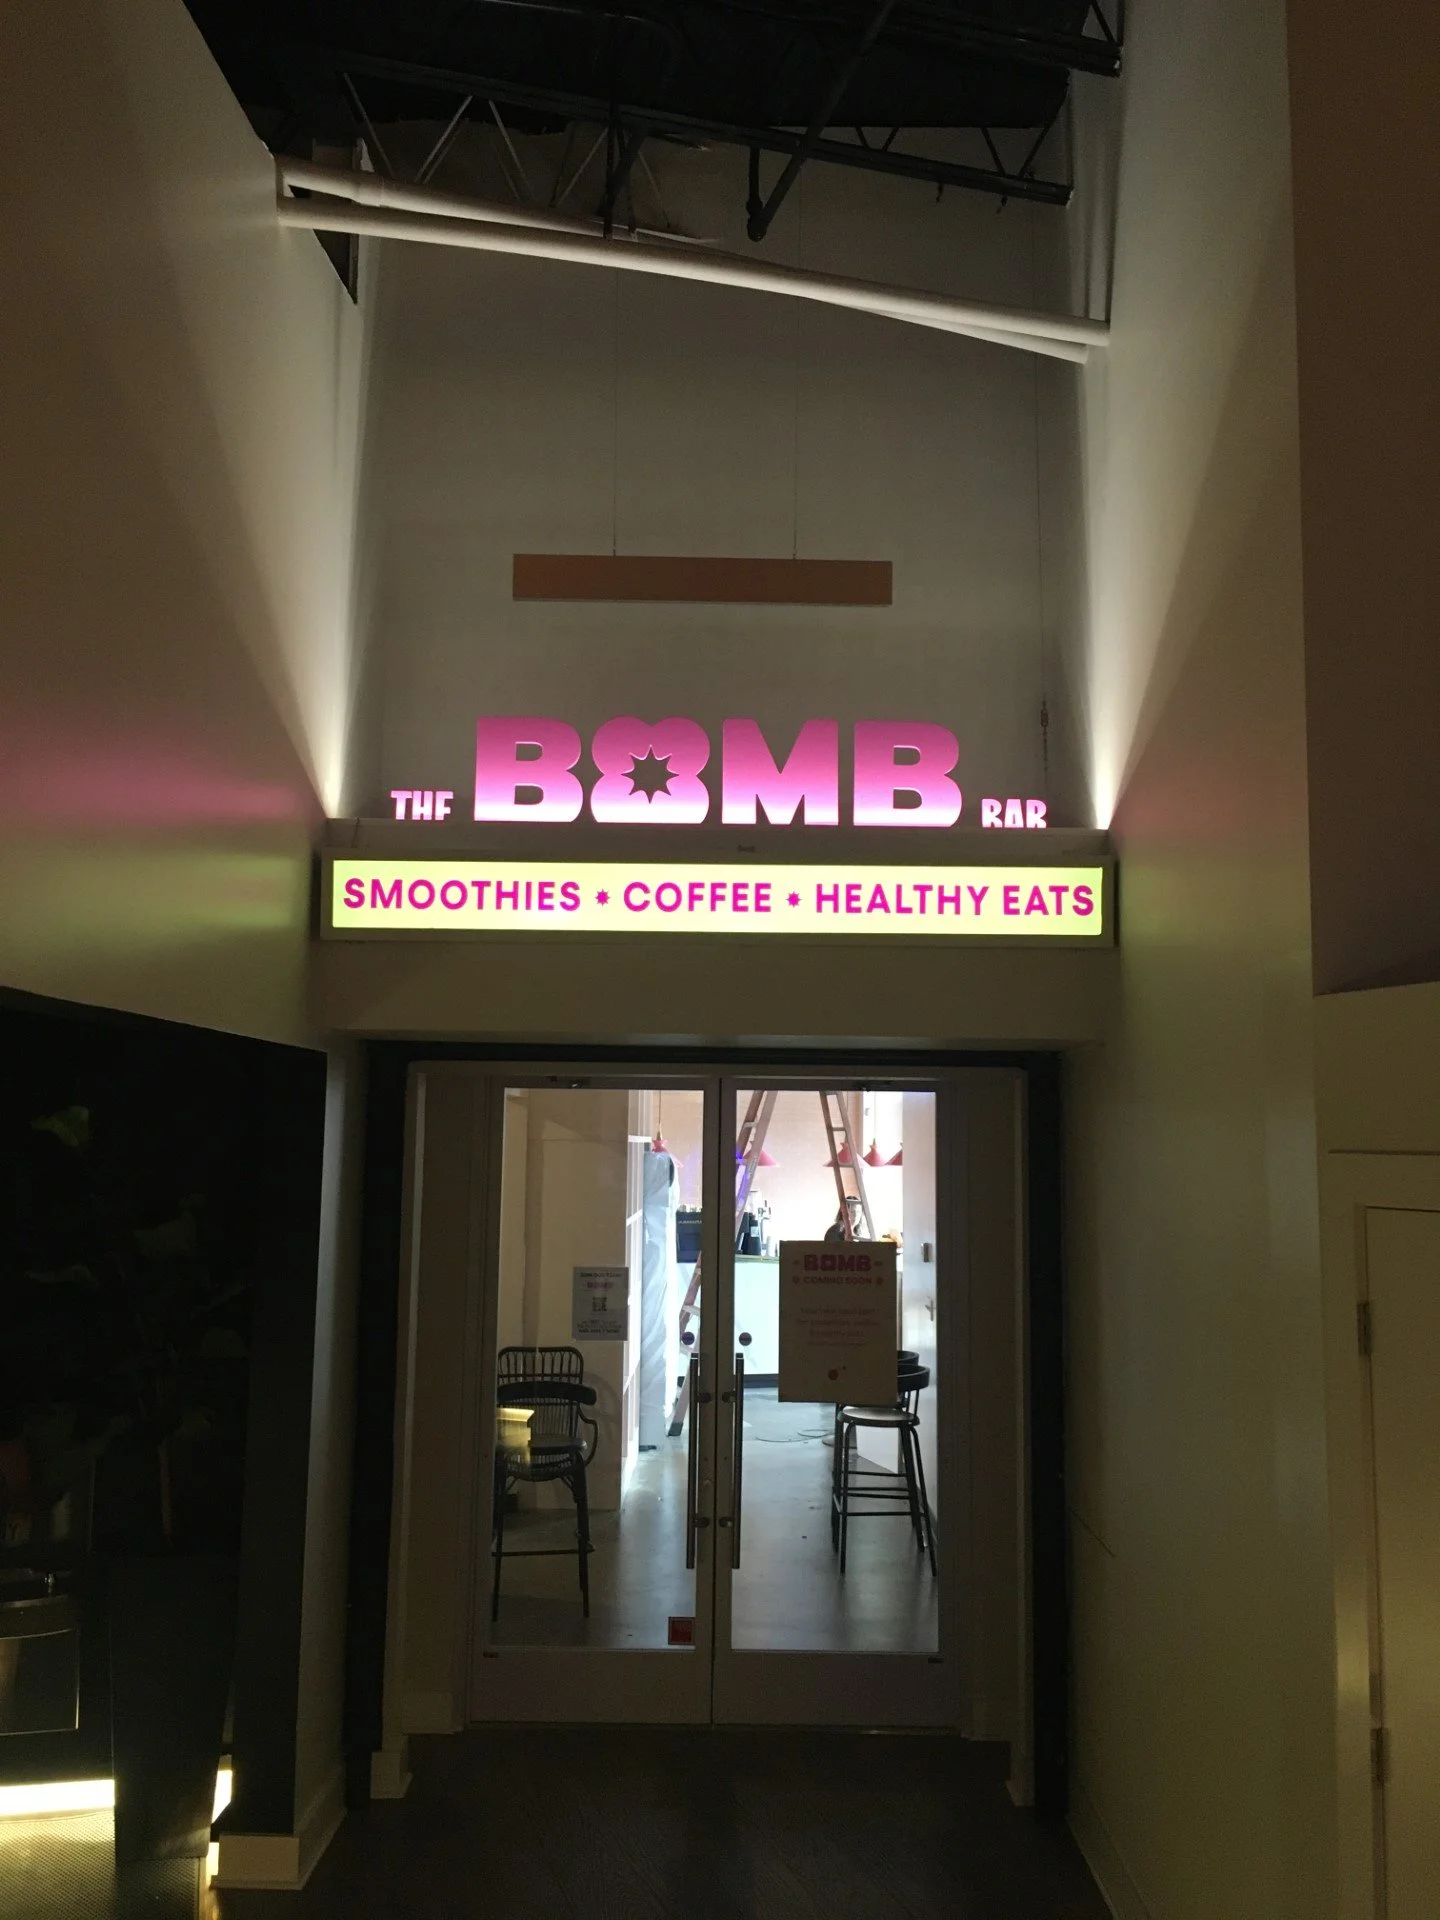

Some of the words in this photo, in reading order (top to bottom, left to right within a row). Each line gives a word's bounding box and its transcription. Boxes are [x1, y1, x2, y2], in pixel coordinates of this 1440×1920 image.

[472, 716, 963, 828] BOMB
[343, 877, 581, 912] SMOOTHIES
[624, 881, 772, 913] COFFEE
[815, 883, 988, 916] HEALTHY
[1002, 885, 1094, 916] EATS
[803, 1254, 872, 1271] BOMB
[845, 1276, 872, 1285] SOON
